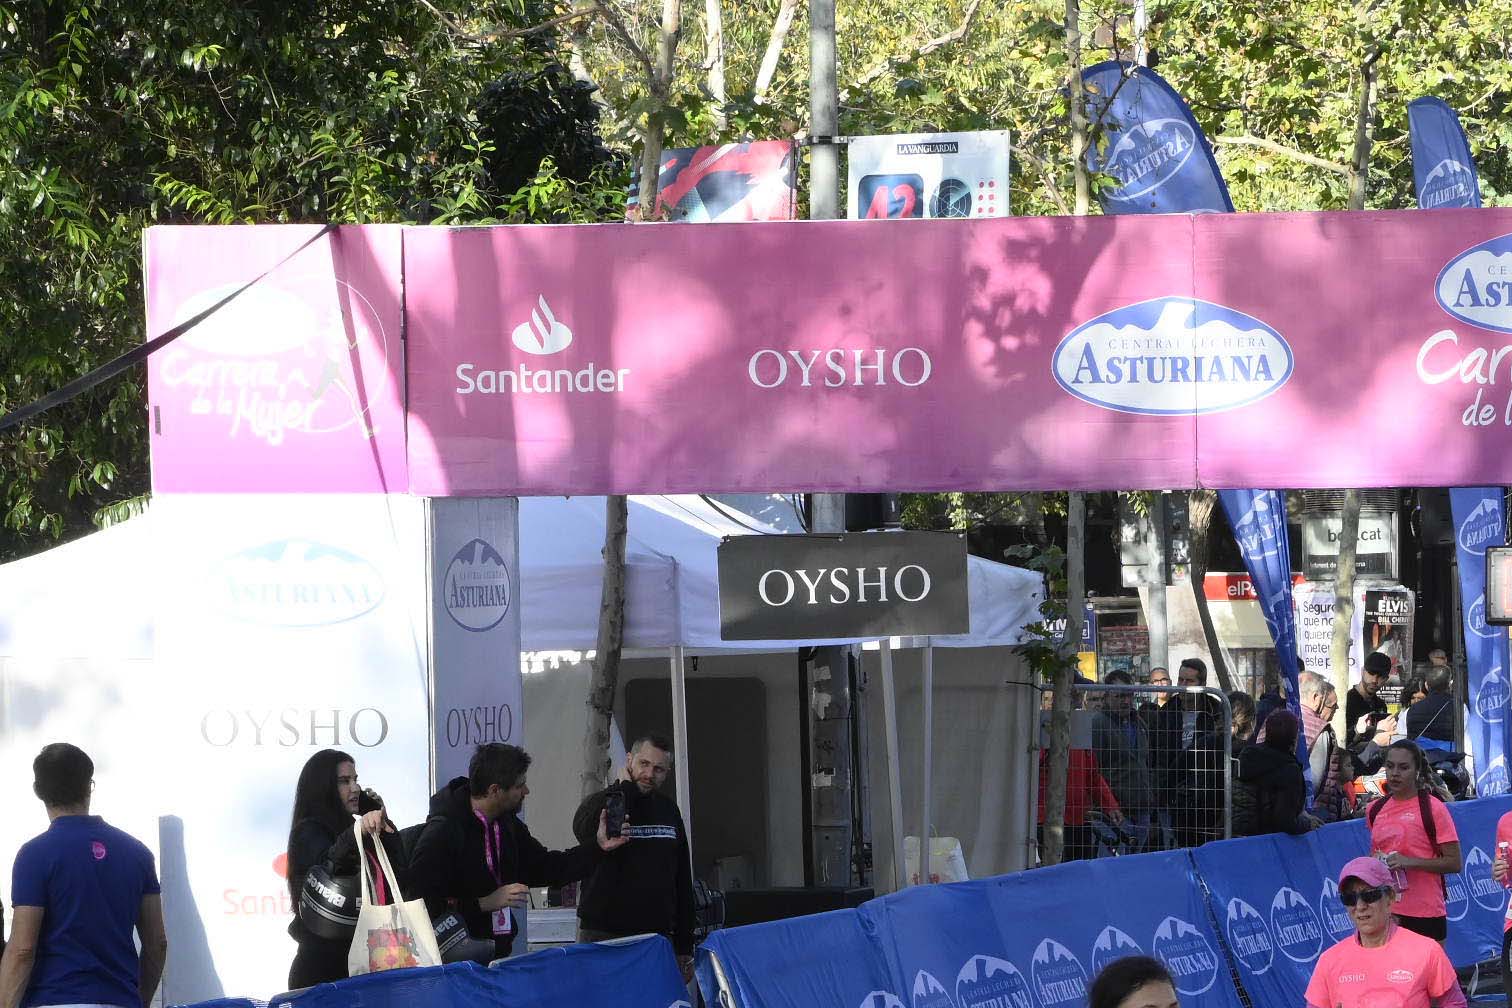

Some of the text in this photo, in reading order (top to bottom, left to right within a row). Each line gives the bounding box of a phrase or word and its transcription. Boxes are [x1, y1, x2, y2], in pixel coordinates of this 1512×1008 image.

[456, 362, 631, 394] Santander
[748, 347, 932, 388] OYSHO
[1071, 341, 1275, 385] ASTURIANA
[1462, 387, 1497, 426] de
[449, 577, 508, 609] ASTURIANA
[758, 564, 931, 607] OYSHO
[1304, 617, 1320, 628] que
[1378, 599, 1409, 613] ELVIS
[1305, 657, 1324, 667] este
[201, 707, 388, 748] OYSHO
[446, 703, 513, 748] OYSHO
